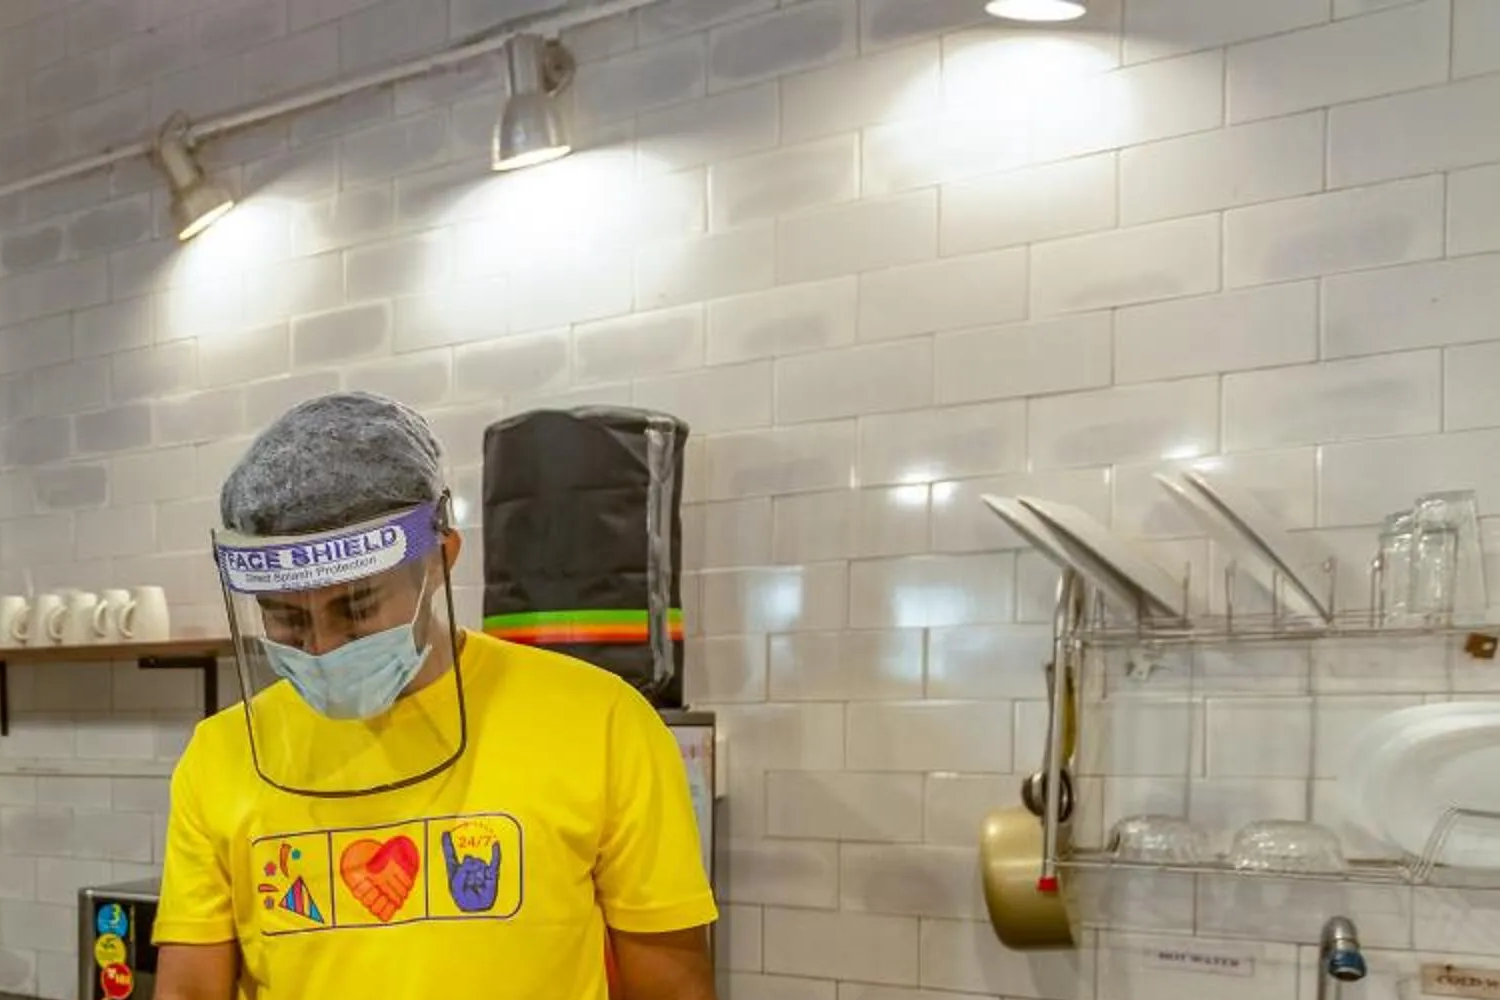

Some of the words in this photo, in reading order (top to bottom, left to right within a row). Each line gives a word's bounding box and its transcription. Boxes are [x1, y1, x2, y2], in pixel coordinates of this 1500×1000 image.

[227, 548, 282, 572] FACE
[291, 527, 397, 567] SHIELD
[315, 556, 377, 577] Protection
[458, 834, 493, 849] 24/7
[1158, 950, 1186, 962] HOT
[1189, 953, 1241, 969] WATER
